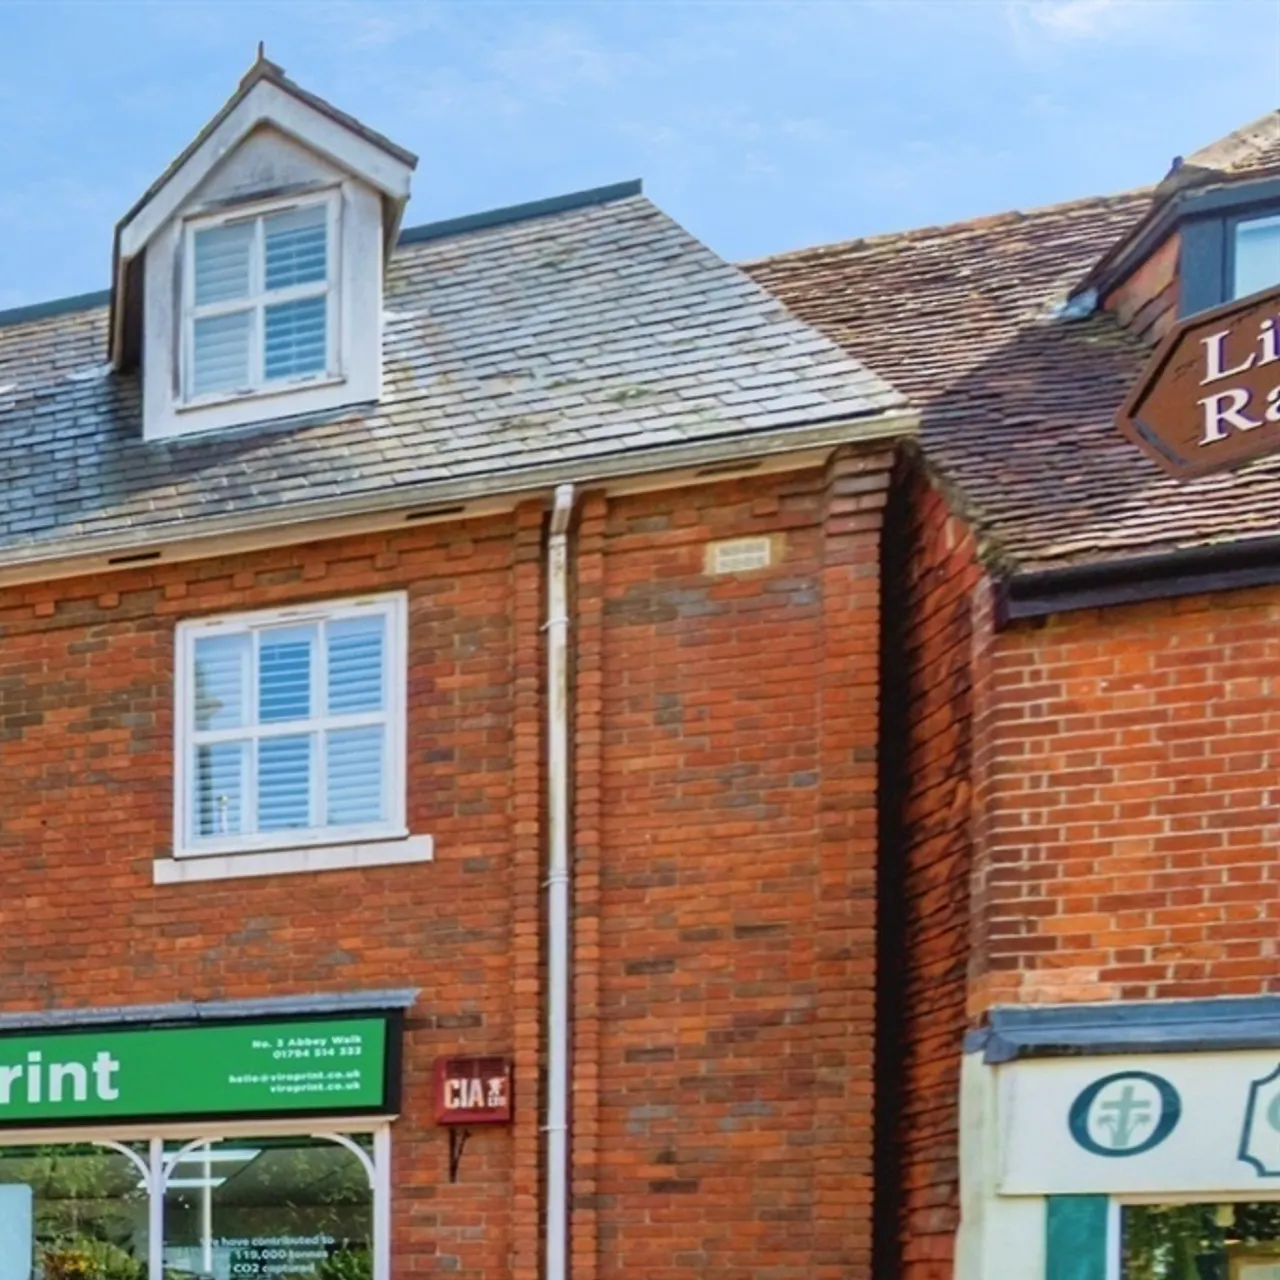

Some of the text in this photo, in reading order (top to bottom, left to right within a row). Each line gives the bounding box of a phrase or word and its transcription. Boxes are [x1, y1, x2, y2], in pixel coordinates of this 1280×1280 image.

[287, 1037, 327, 1048] Abbey
[331, 1035, 361, 1045] Walk
[270, 1081, 360, 1094] viroprint.co.uk
[444, 1078, 484, 1109] CIA
[221, 1236, 249, 1247] have
[251, 1234, 320, 1246] contributed
[233, 1262, 259, 1274] CO2
